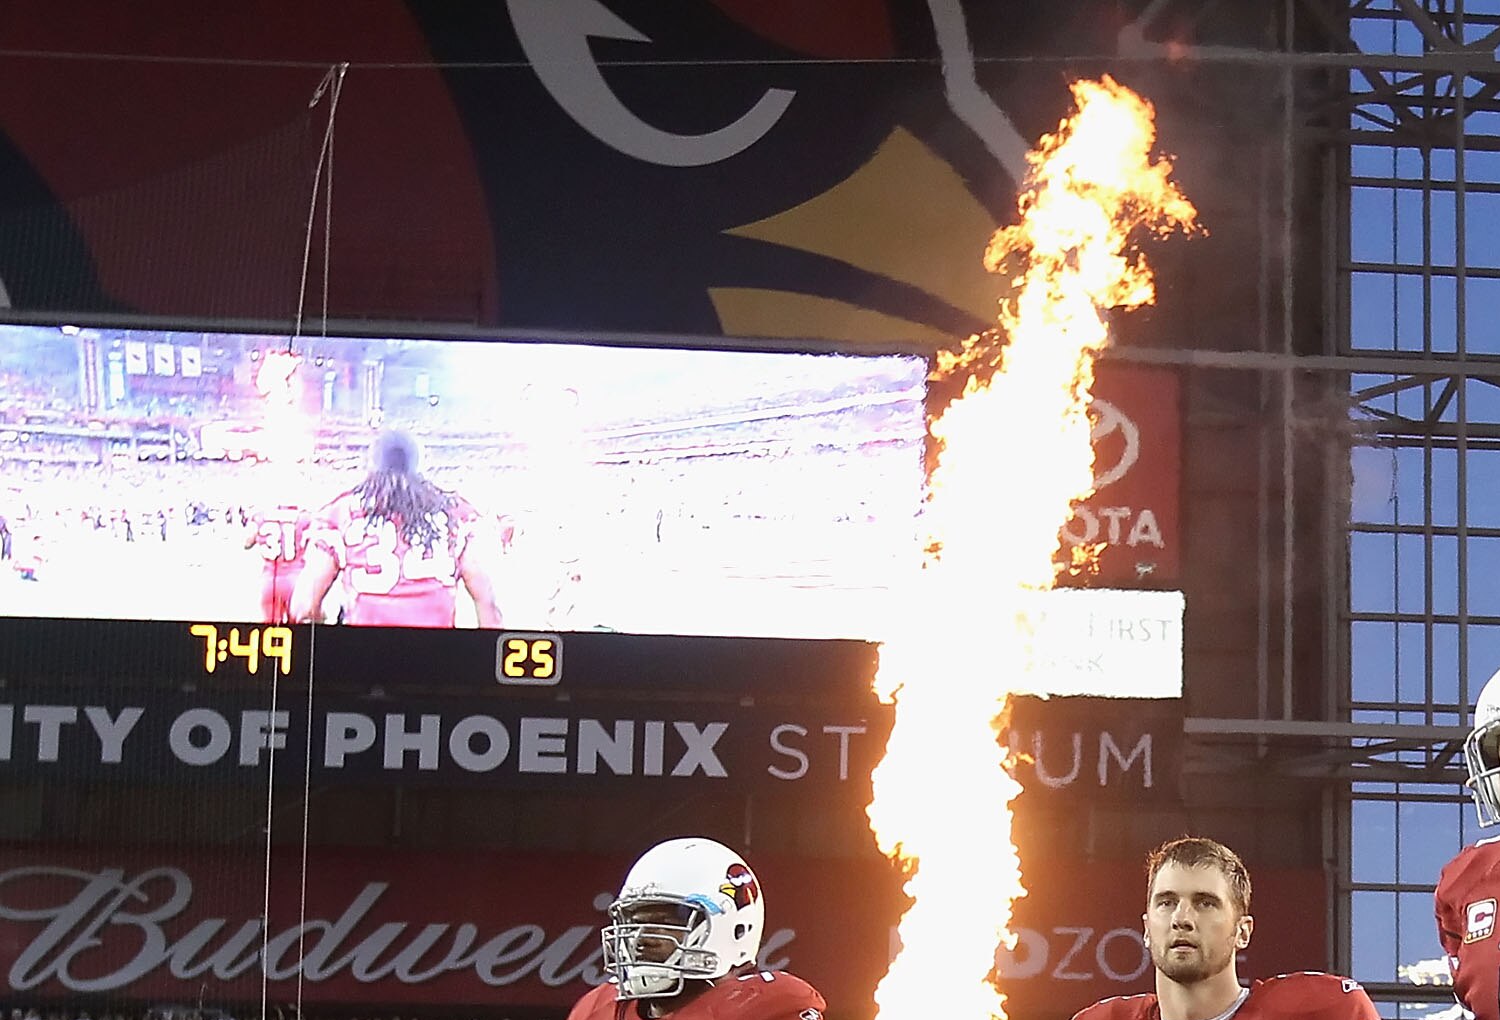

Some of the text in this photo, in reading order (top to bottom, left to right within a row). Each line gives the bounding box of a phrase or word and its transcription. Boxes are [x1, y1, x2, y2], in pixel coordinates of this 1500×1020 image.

[1061, 505, 1165, 550] OTA
[189, 624, 294, 675] 7:49
[503, 638, 555, 679] 25
[169, 707, 290, 767] OF
[323, 710, 730, 778] PHOENIX
[0, 865, 797, 993] Budwei
[1466, 899, 1495, 929] C
